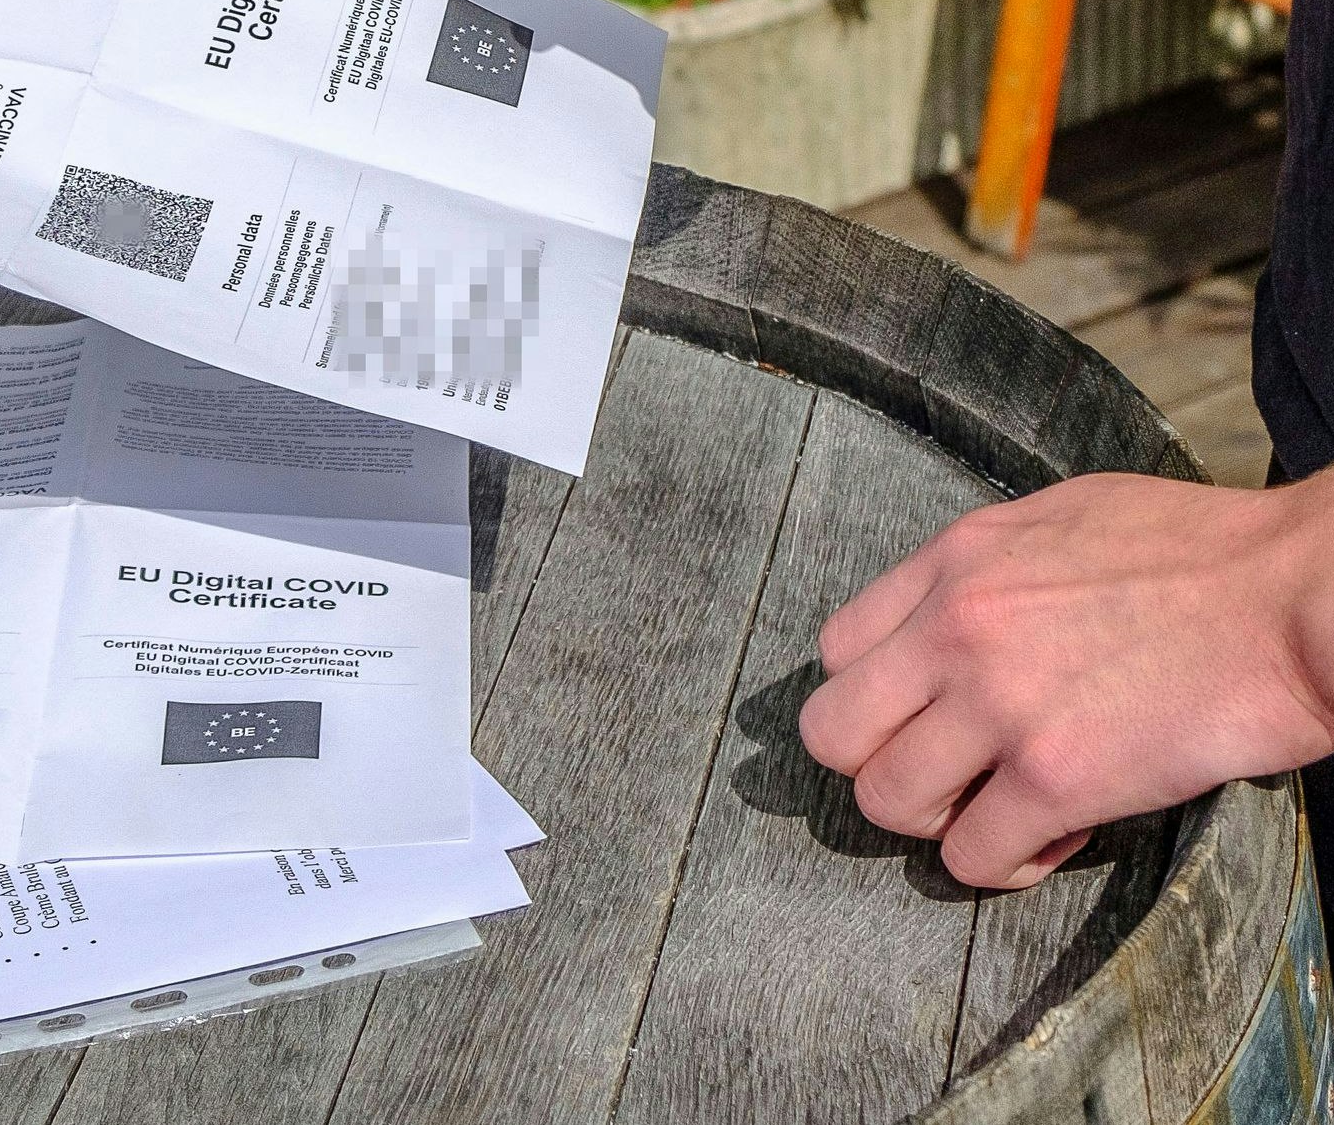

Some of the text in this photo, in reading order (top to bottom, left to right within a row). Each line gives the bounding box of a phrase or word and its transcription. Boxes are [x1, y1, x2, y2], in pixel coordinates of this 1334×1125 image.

[204, 36, 235, 69] EU
[352, 29, 374, 68] Digitaal
[477, 40, 492, 57] BE
[323, 55, 348, 102] Certificat
[348, 69, 361, 85] EU
[365, 45, 388, 90] Digitales
[221, 214, 262, 292] Personal data
[258, 210, 300, 308] Données personnelles
[279, 221, 316, 307] Persoonsgegevens
[298, 226, 334, 309] Persönliche Daten
[117, 565, 389, 597] EU Digital COVID
[168, 589, 337, 610] Certificate
[103, 639, 393, 658] Certificat Numérique Européen COVID
[136, 652, 360, 668] EU Digitaal COVID-Certificaat
[135, 663, 202, 676] Digitales
[230, 727, 256, 738] BE
[274, 854, 305, 895] En raison
[311, 868, 331, 889] dans
[335, 857, 358, 883] Merci
[35, 893, 59, 928] Crème
[54, 865, 89, 923] Fondant au
[8, 899, 32, 934] Coupe
